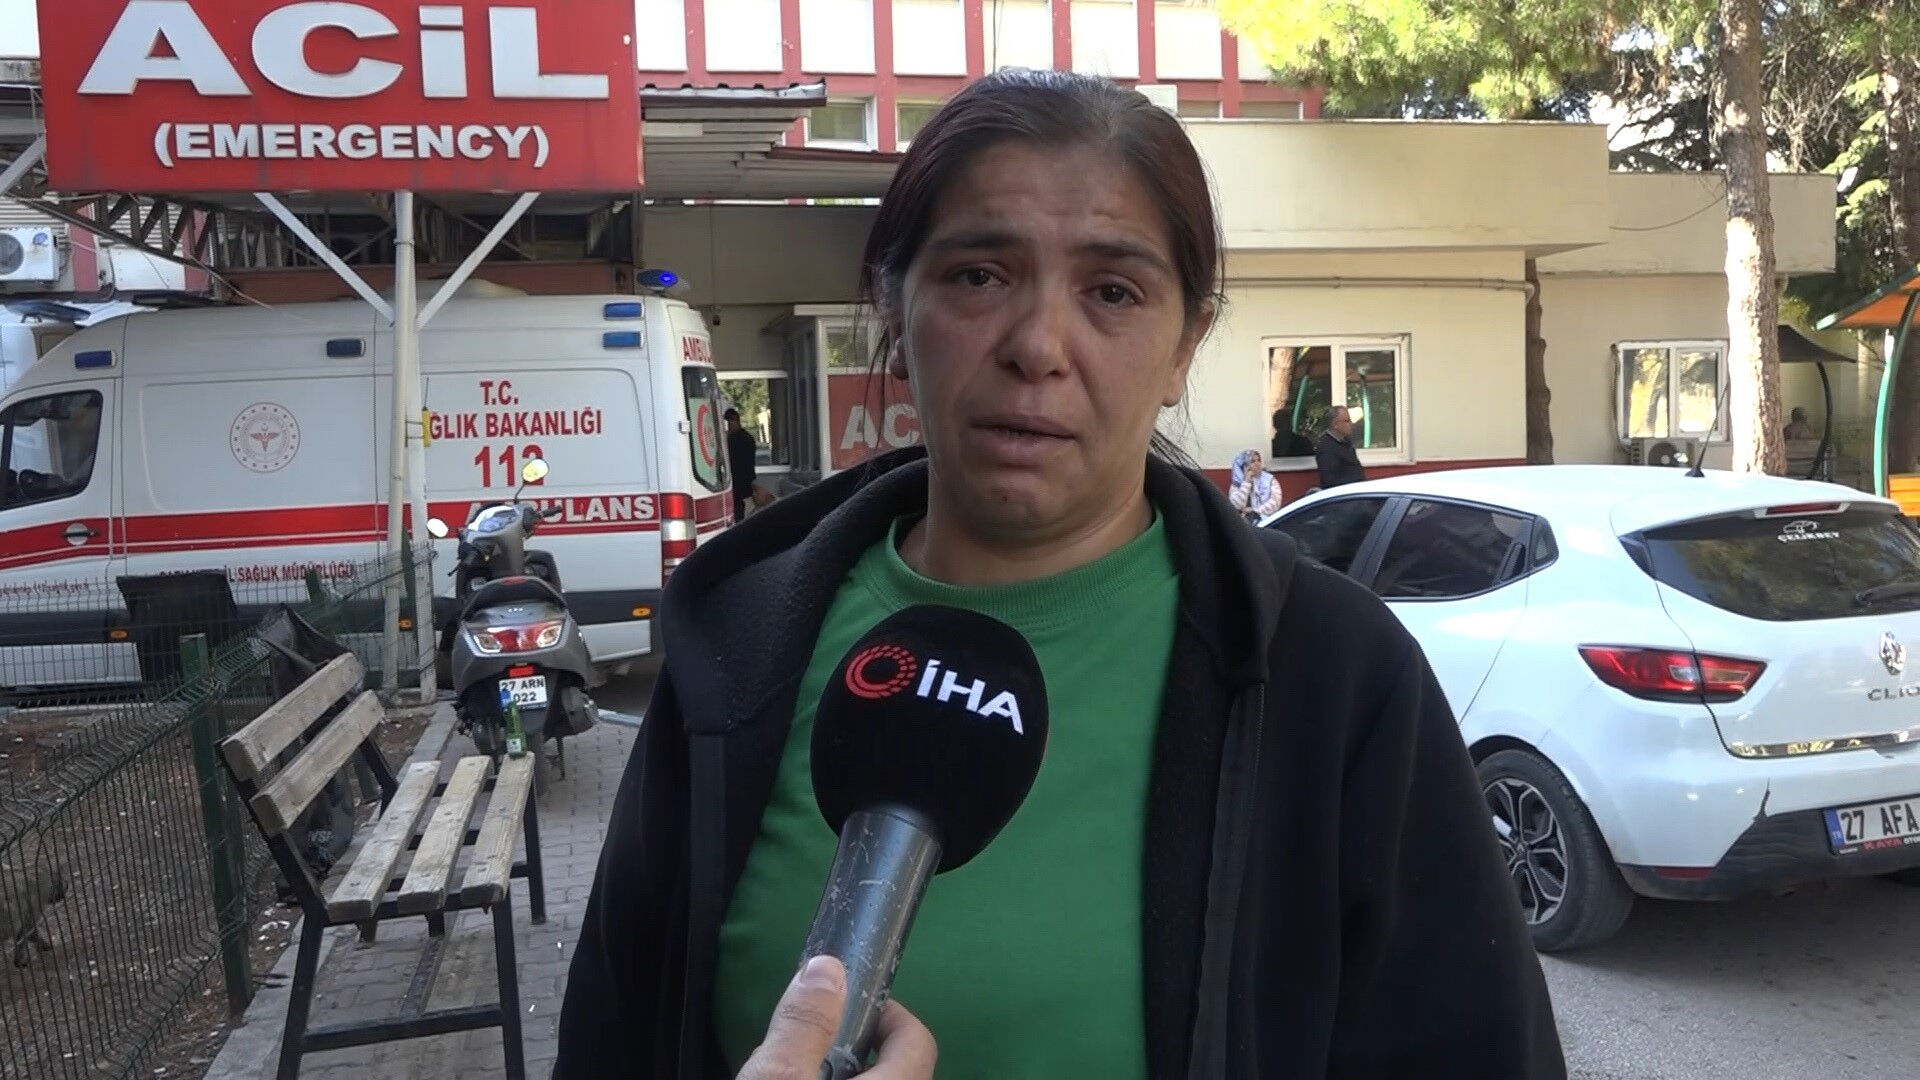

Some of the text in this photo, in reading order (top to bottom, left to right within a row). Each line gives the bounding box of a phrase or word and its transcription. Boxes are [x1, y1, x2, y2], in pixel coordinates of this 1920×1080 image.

[154, 121, 549, 168] (EMERGENCY)
[480, 381, 518, 405] T.C.
[429, 407, 602, 440] ĞLIK BAKANLIĞI
[840, 403, 920, 450] AC
[502, 678, 544, 691] 27 ARN
[513, 691, 537, 703] 022
[1867, 686, 1920, 701] CLIO
[1840, 802, 1920, 841] 27 AFA
